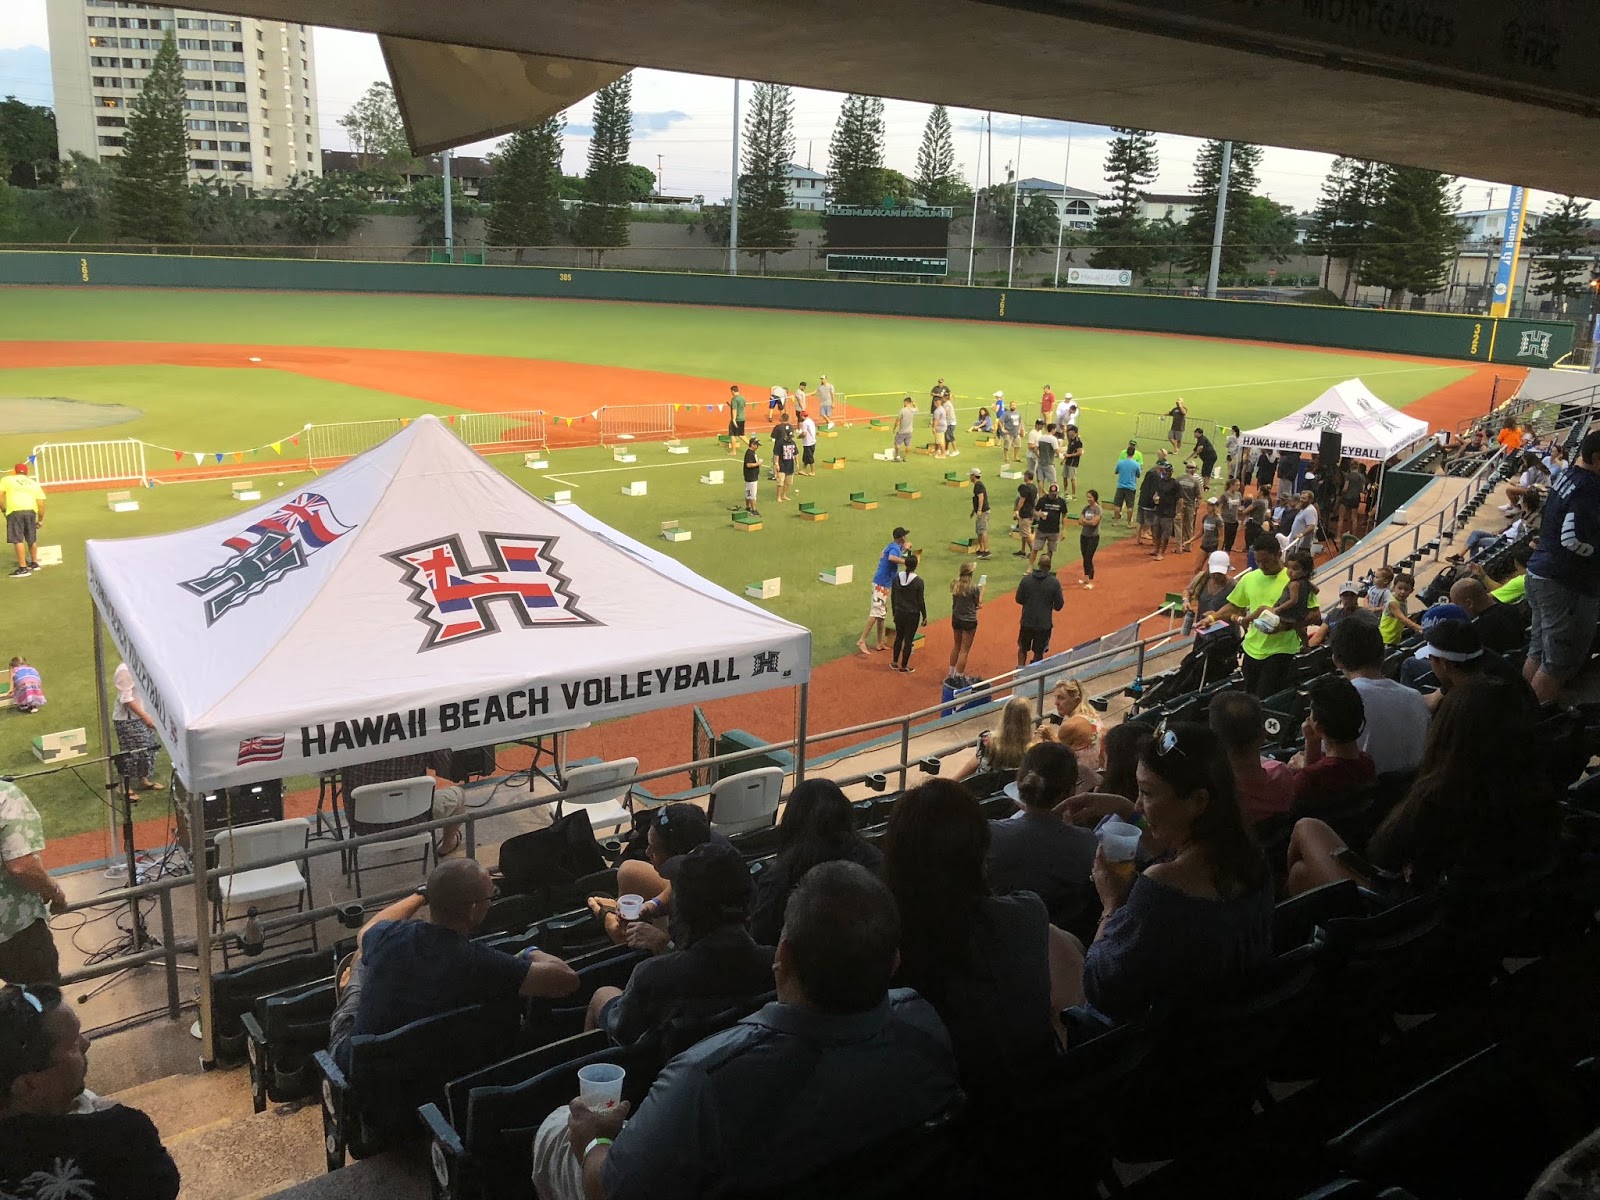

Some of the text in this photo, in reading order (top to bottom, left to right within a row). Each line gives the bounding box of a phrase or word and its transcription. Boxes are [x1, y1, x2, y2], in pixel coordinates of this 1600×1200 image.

[1505, 223, 1517, 248] Bank
[1511, 211, 1519, 222] of
[80, 258, 89, 282] 365
[559, 273, 572, 281] 385
[1470, 323, 1482, 355] 325
[1243, 436, 1384, 459] HAWAII BEACH EYBALL
[300, 707, 427, 758] HAWAII
[438, 686, 549, 733] BEACH
[560, 656, 740, 710] VOLLEYBALL
